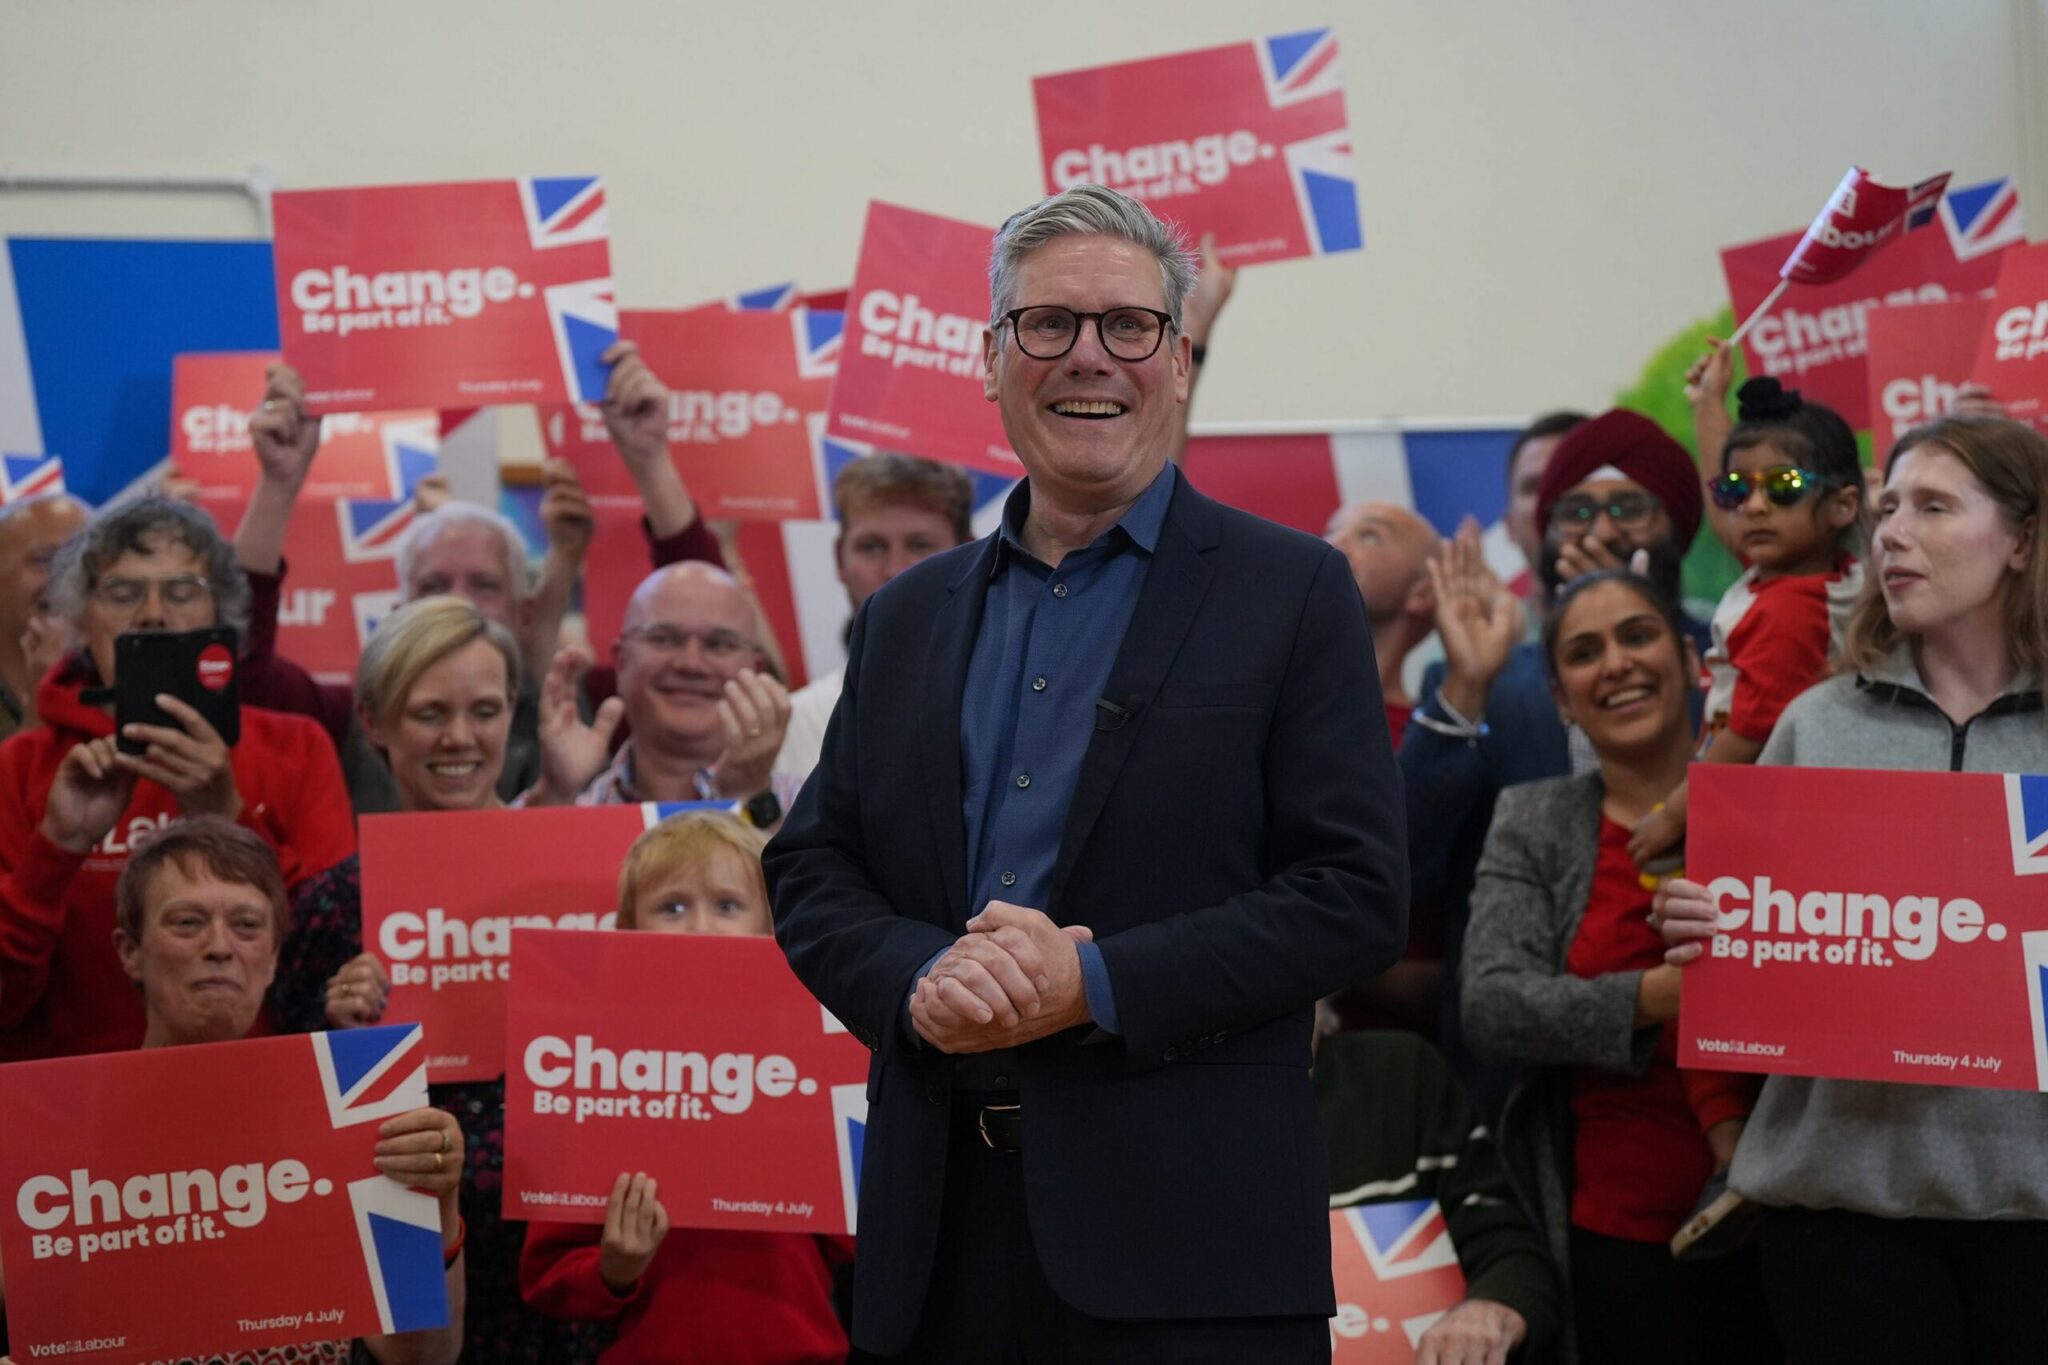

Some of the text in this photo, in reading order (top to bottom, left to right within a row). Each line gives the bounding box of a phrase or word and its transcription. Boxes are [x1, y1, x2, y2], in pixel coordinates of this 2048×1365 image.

[1052, 130, 1276, 191] Change.
[291, 266, 534, 318] Change.
[303, 304, 452, 337] Be part of it.
[1707, 876, 2007, 961] Change.
[1711, 934, 1894, 968] Be part of it.
[391, 963, 428, 985] Be
[432, 959, 493, 991] part
[1697, 1038, 1786, 1056] Vote Labour
[1893, 1050, 2002, 1073] Thursday 4 July
[523, 1035, 817, 1114] Change.
[533, 1091, 712, 1123] Be part of it.
[17, 1159, 333, 1230] Change.
[712, 1198, 814, 1218] Thursday 4 July
[32, 1212, 226, 1262] Be part of it.
[237, 1308, 345, 1332] Thursday 4 July
[29, 1336, 127, 1358] Vote Labour
